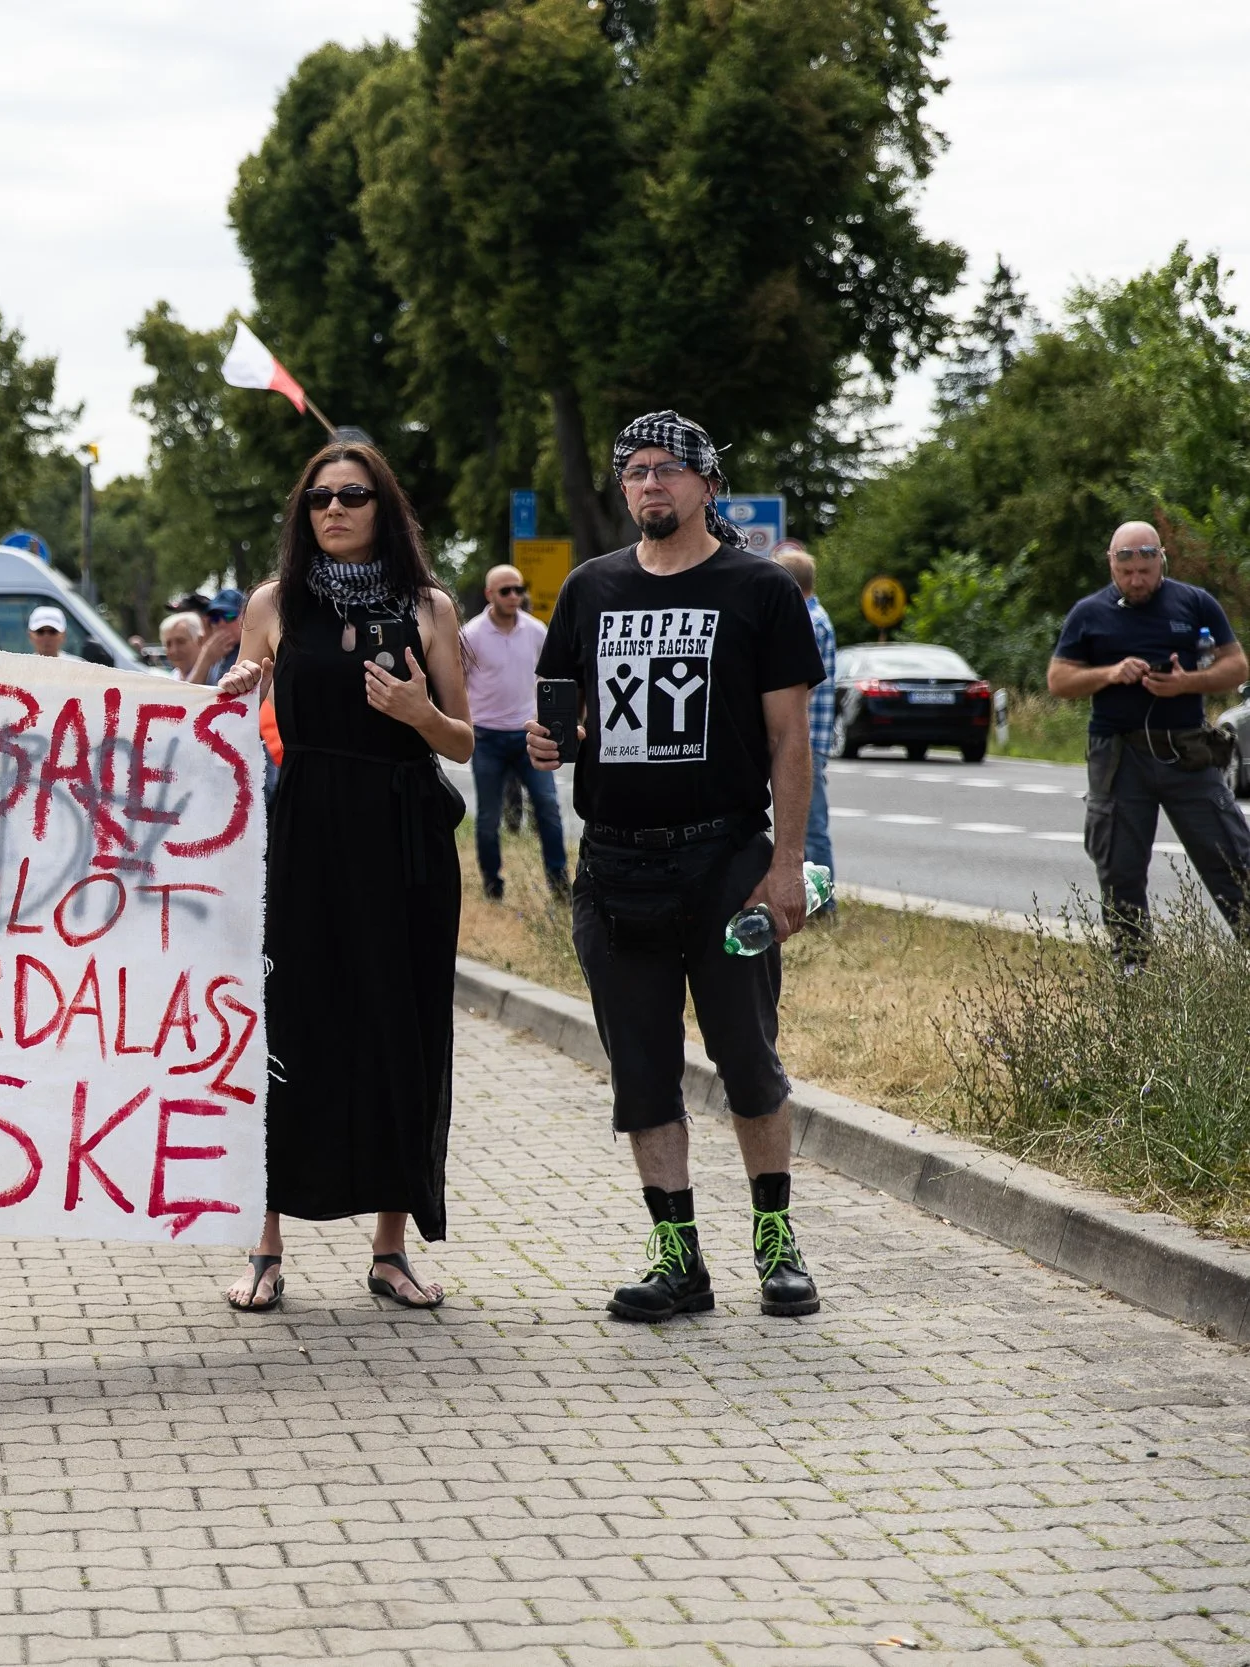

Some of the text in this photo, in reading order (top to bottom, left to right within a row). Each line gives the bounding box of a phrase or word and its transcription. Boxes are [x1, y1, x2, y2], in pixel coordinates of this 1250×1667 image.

[601, 612, 716, 639] PEOPLE
[599, 638, 707, 657] AGAINST RACISM
[603, 746, 617, 757] ONE
[619, 745, 640, 756] RACE
[648, 744, 680, 756] HUMAN
[682, 743, 702, 755] RACE
